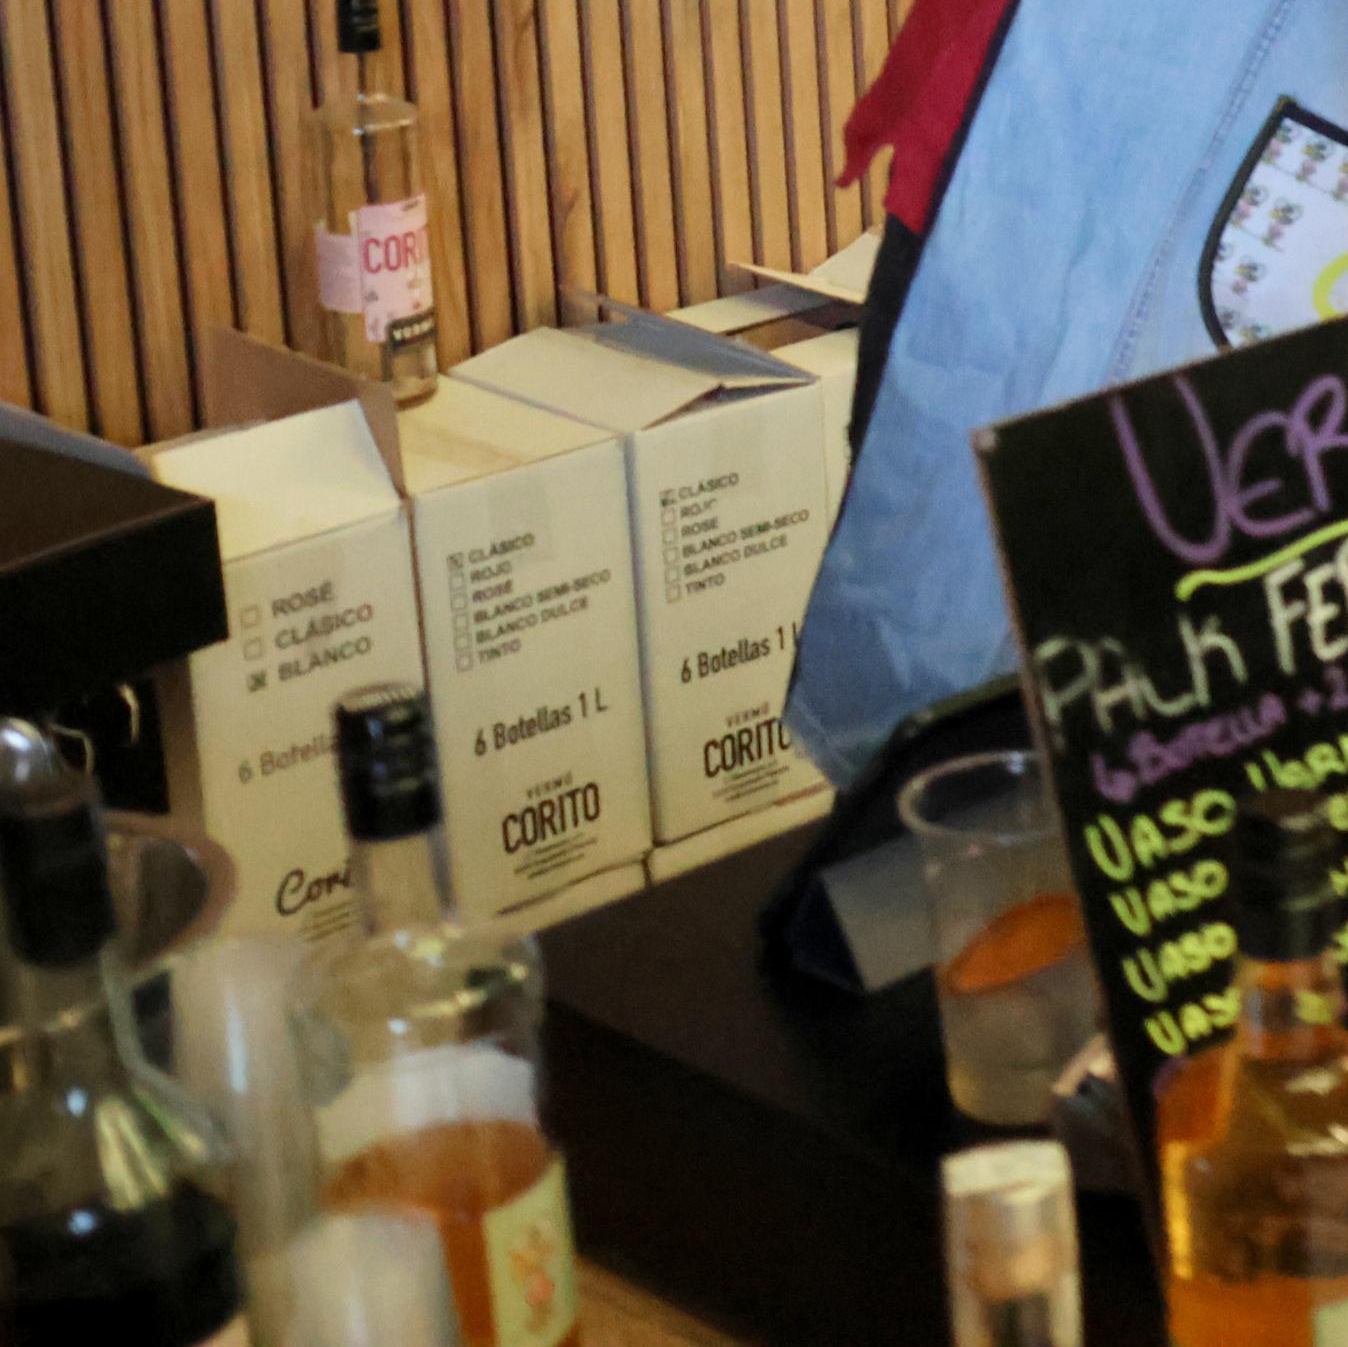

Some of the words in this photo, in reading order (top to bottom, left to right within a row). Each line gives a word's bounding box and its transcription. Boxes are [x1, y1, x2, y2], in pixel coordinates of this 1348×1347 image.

[278, 635, 373, 684] BLANCO
[681, 656, 692, 685] 6
[698, 629, 772, 680] Botellas
[777, 625, 785, 652] 1
[474, 728, 488, 757] 6
[493, 698, 573, 753] Botellas
[577, 692, 588, 721] 1
[594, 686, 609, 713] L
[502, 782, 601, 854] CORITO
[1083, 788, 1237, 882] VASO
[1109, 858, 1229, 937] VASO
[1121, 921, 1238, 1002] VASO
[1144, 985, 1241, 1057] VAS
